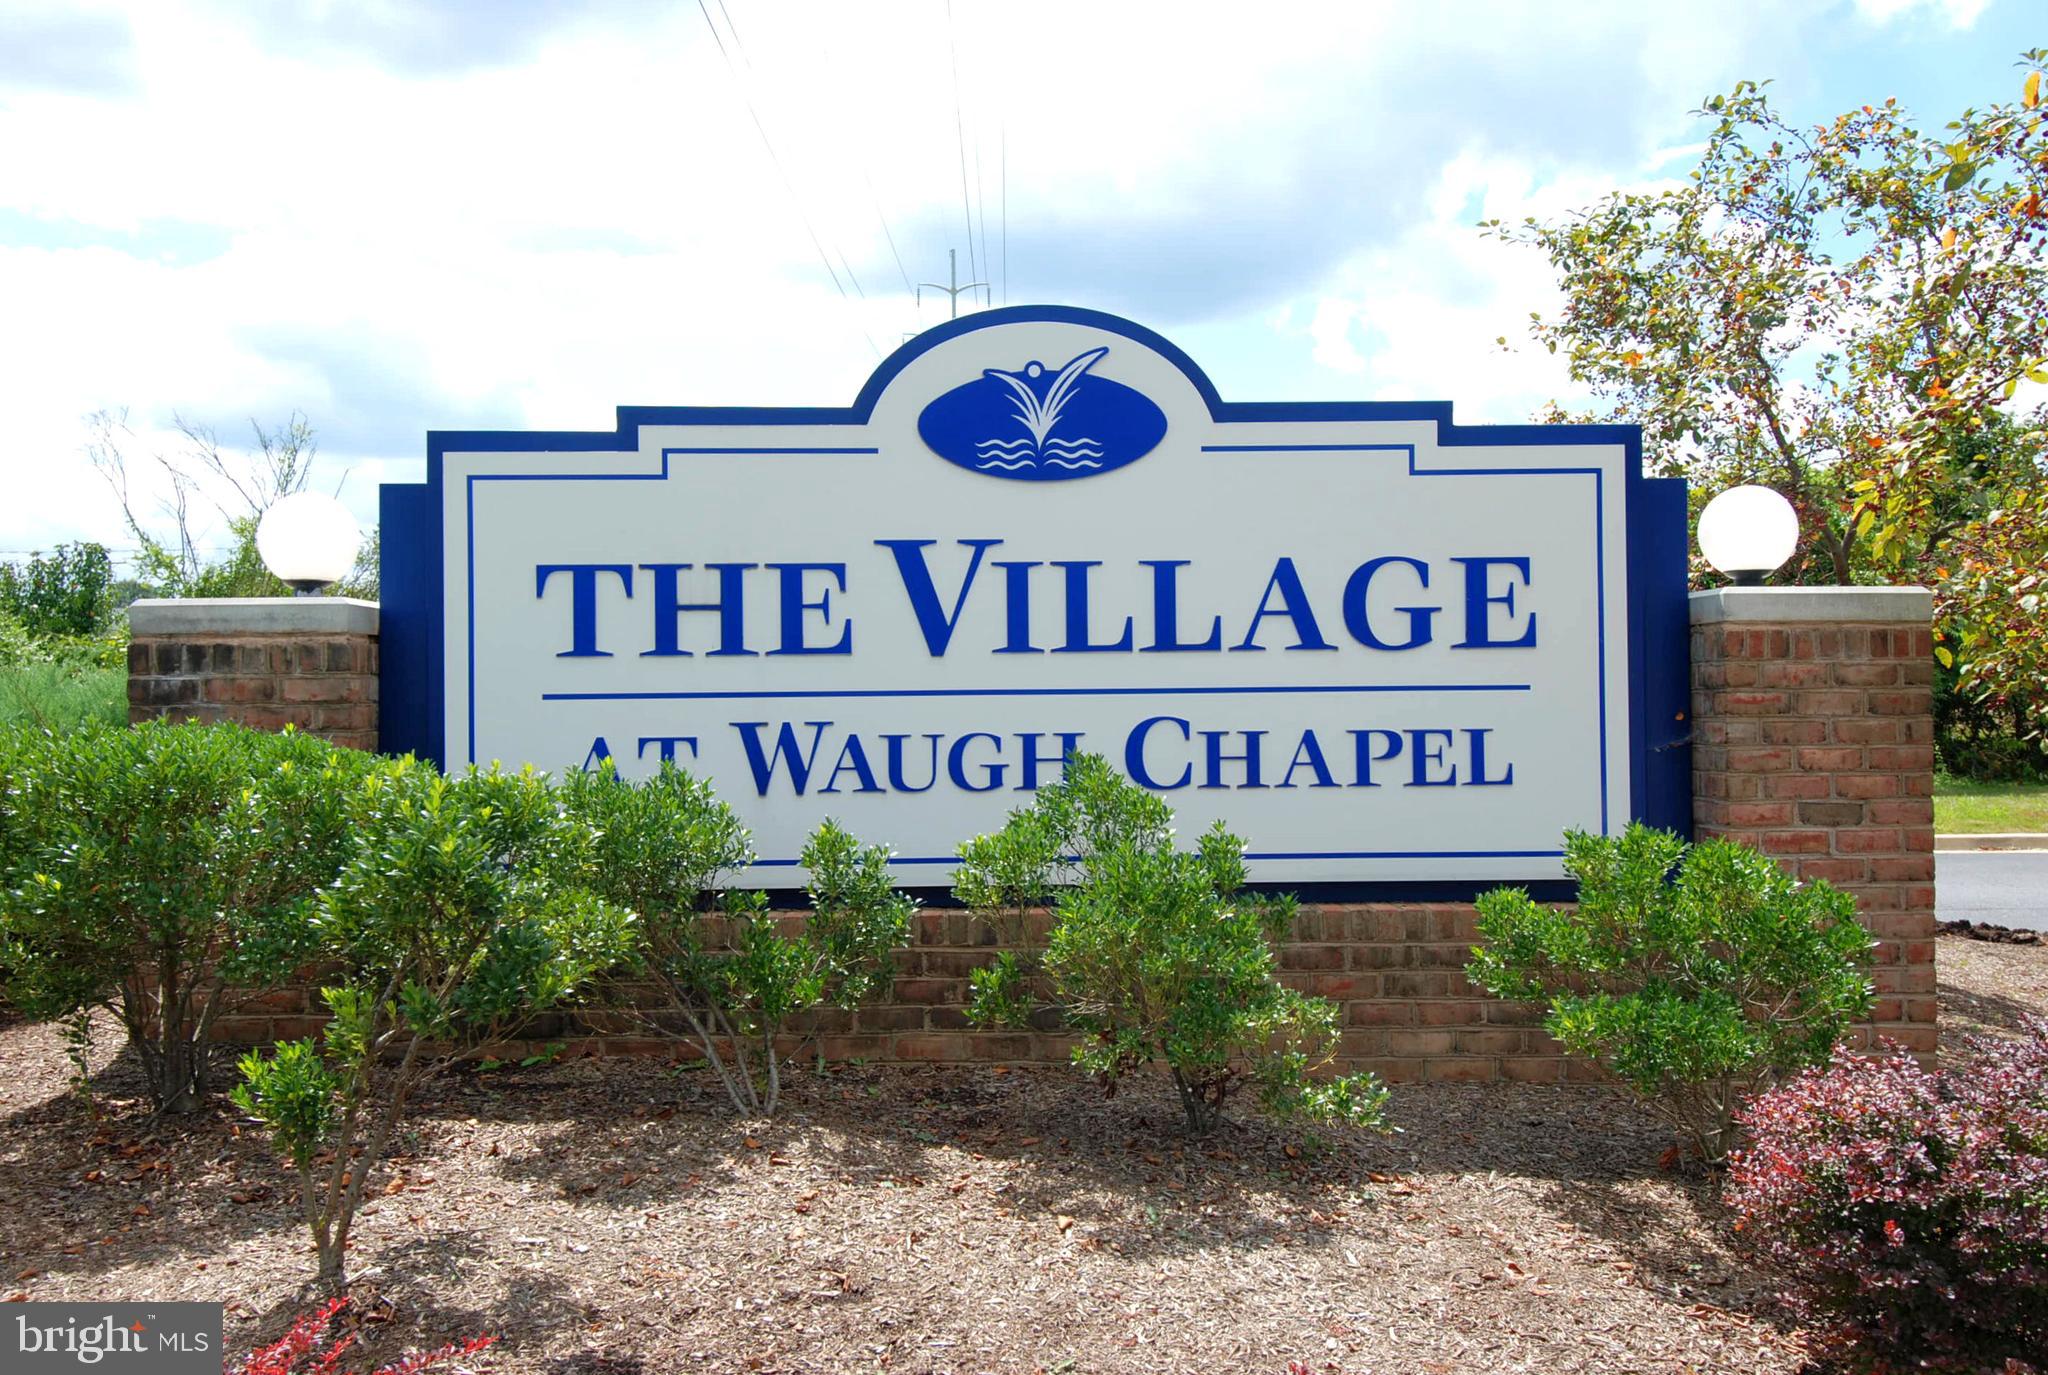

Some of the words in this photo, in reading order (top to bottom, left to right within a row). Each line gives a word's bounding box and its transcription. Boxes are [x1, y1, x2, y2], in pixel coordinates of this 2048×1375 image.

[535, 562, 853, 658] THE
[873, 538, 1537, 658] VILLAGE
[728, 721, 1086, 797] WAUGH
[1124, 716, 1514, 792] CHAPEL
